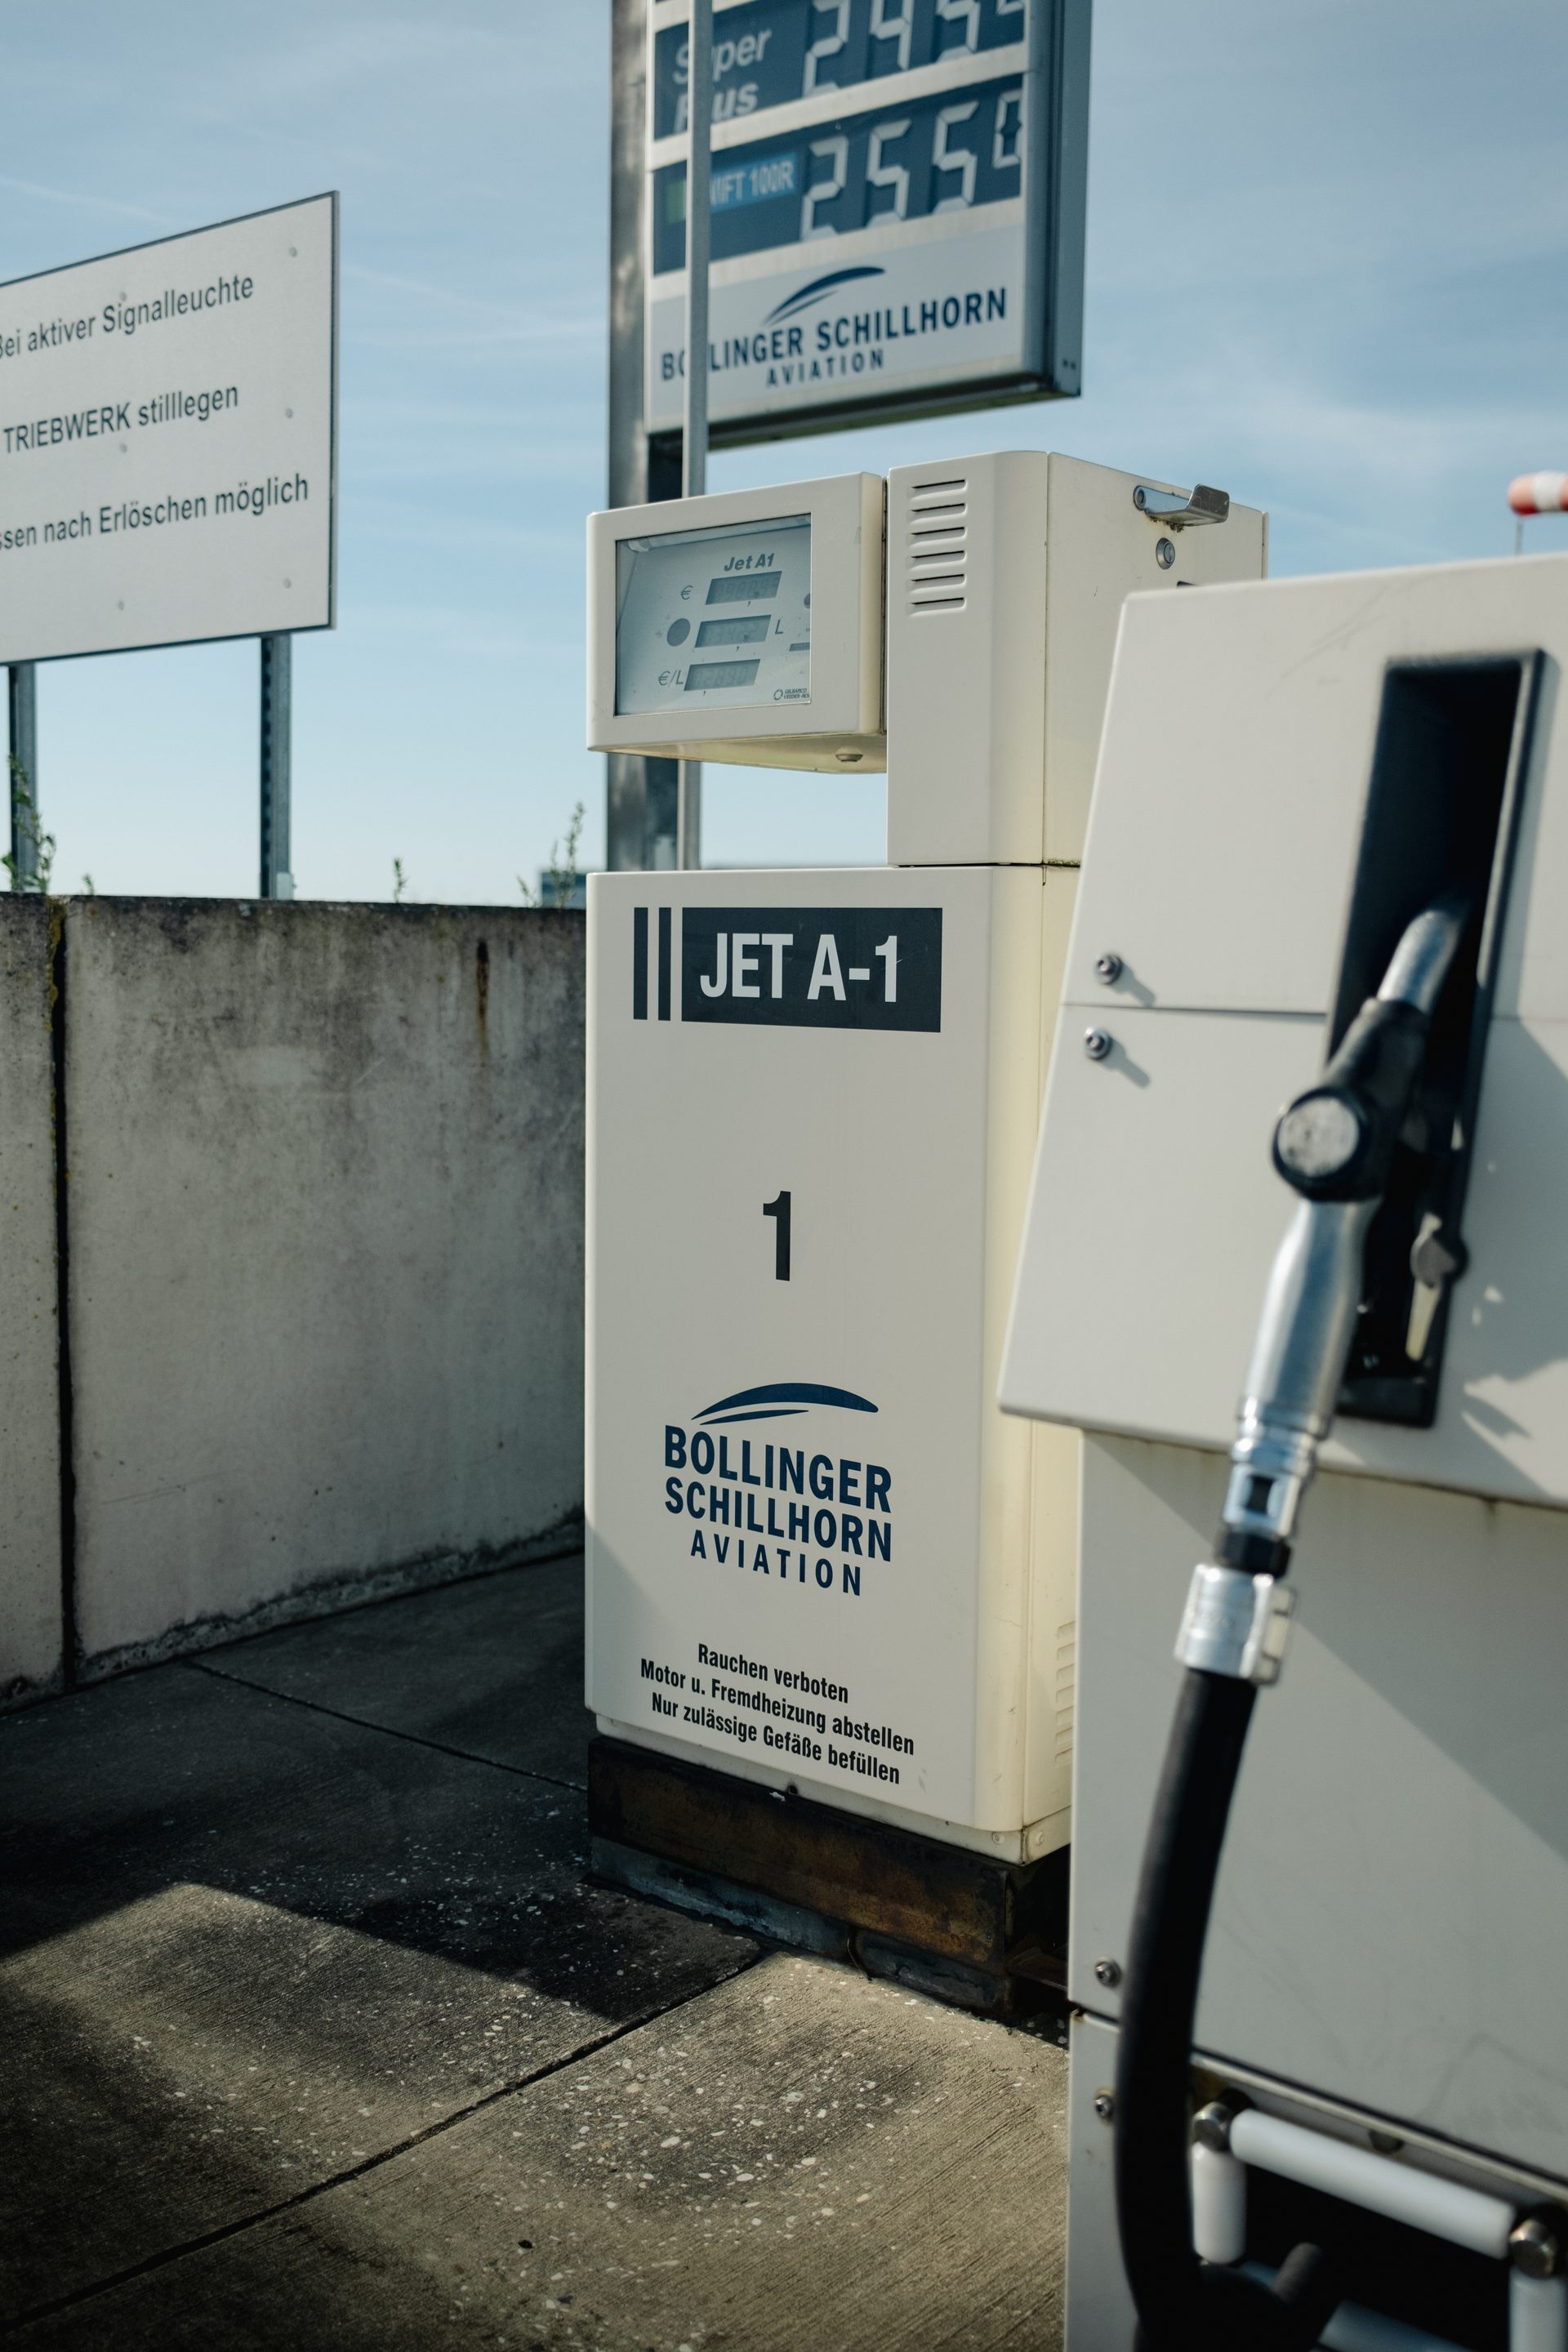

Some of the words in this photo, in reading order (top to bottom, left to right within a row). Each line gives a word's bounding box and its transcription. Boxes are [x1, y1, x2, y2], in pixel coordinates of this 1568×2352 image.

[672, 29, 772, 83] Sper
[28, 315, 96, 352] aktiver
[103, 274, 254, 336] Signalleuchte
[662, 327, 803, 381] BLINGER
[817, 287, 1006, 351] SCHILLHORN
[766, 349, 884, 388] AVIATION
[3, 402, 131, 453] TRIEBWERK
[138, 385, 238, 425] stilllegen
[45, 511, 91, 543] nach
[100, 496, 207, 534] Erlöschen
[216, 473, 309, 516] möglich
[680, 585, 693, 600] €
[724, 555, 752, 572] Jet
[755, 552, 775, 568] A1
[775, 619, 784, 635] L
[657, 670, 684, 688] €/L
[700, 933, 794, 999] JET
[807, 933, 898, 1003] A-1
[763, 1190, 791, 1281] 1
[665, 1424, 892, 1513] BOLLINGER
[665, 1477, 892, 1562] SCHILLHORN
[690, 1530, 862, 1597] AVIATION
[640, 1658, 686, 1689] Motor
[691, 1677, 706, 1695] u.
[711, 1678, 826, 1734] Fremdheizung
[832, 1716, 915, 1755] abstellen
[698, 1643, 768, 1681] Rauchen
[774, 1668, 849, 1704] verboten
[652, 1691, 679, 1717] Nur
[684, 1705, 757, 1743] zulässige
[764, 1725, 822, 1761] Gefäße
[828, 1744, 900, 1784] befüllen
